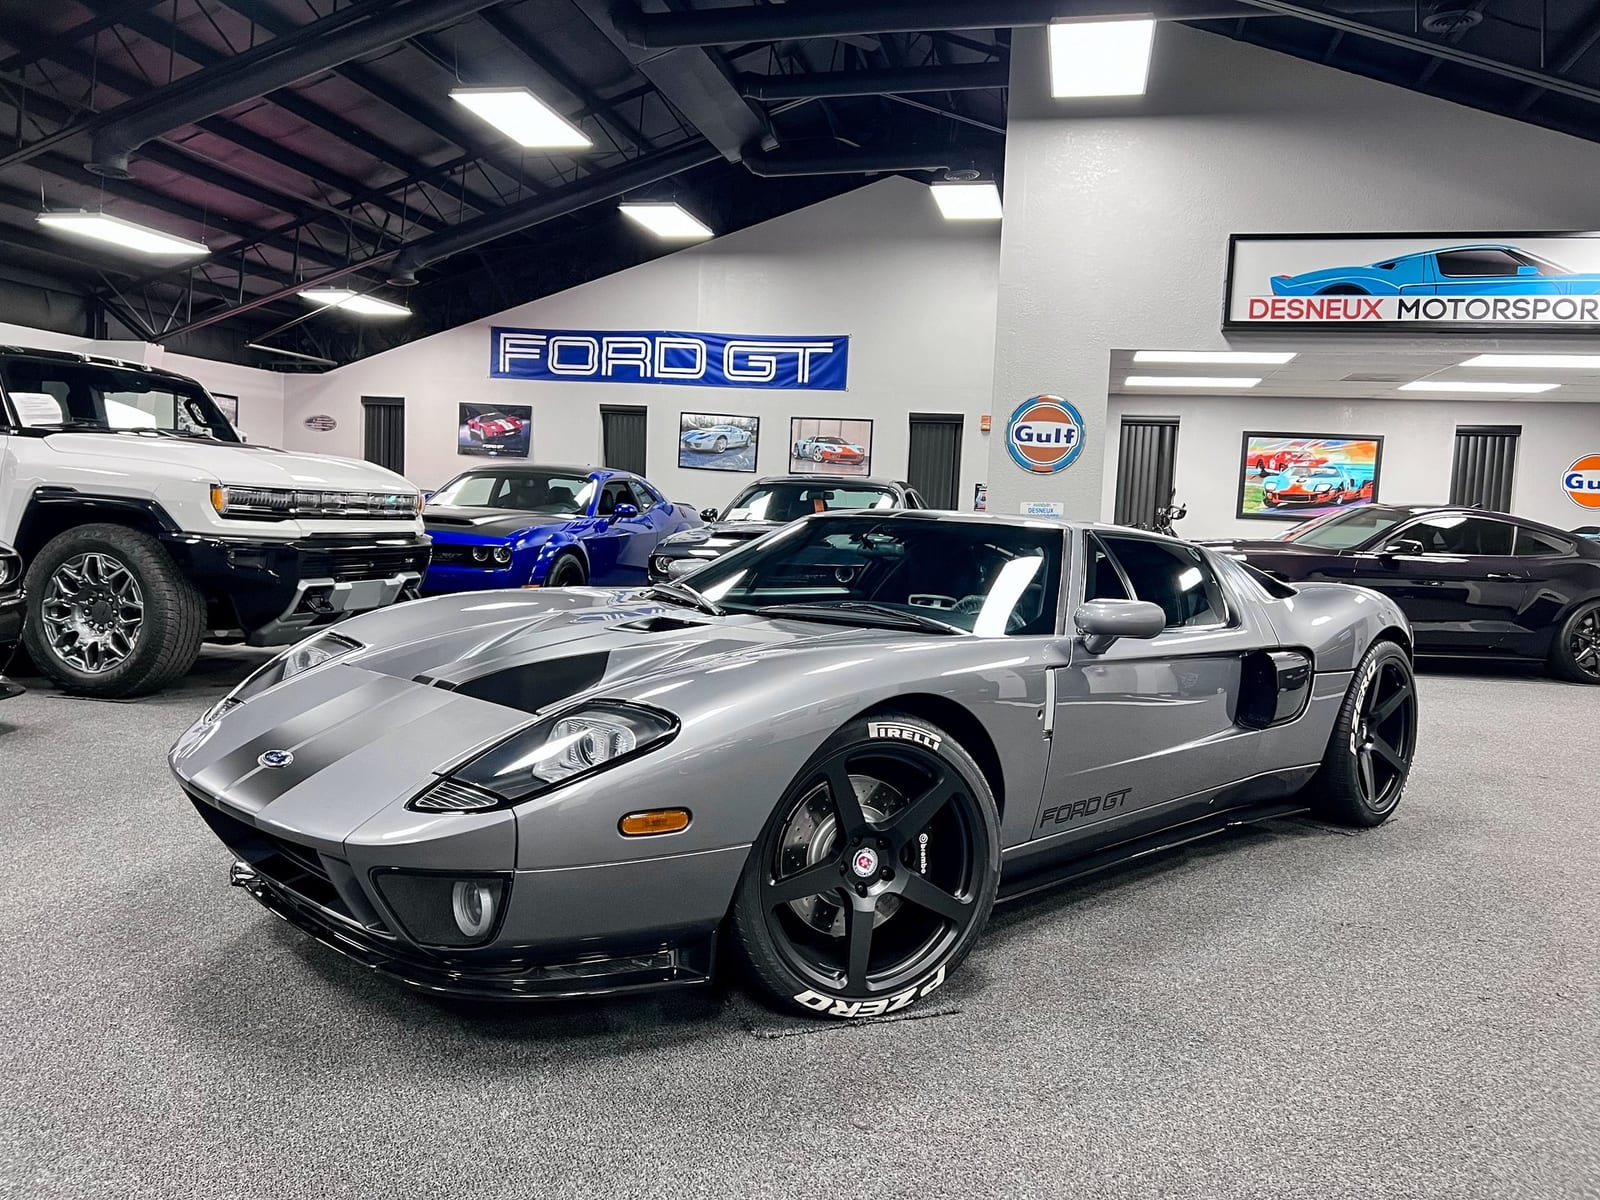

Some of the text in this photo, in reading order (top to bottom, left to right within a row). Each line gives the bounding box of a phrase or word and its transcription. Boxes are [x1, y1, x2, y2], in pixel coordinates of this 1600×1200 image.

[1249, 298, 1383, 319] DESNEUX
[499, 332, 834, 384] FORD GT
[1015, 425, 1075, 443] Gulf
[868, 722, 942, 751] PIRELLI
[1040, 787, 1132, 828] FORD GT
[920, 843, 928, 875] brembo
